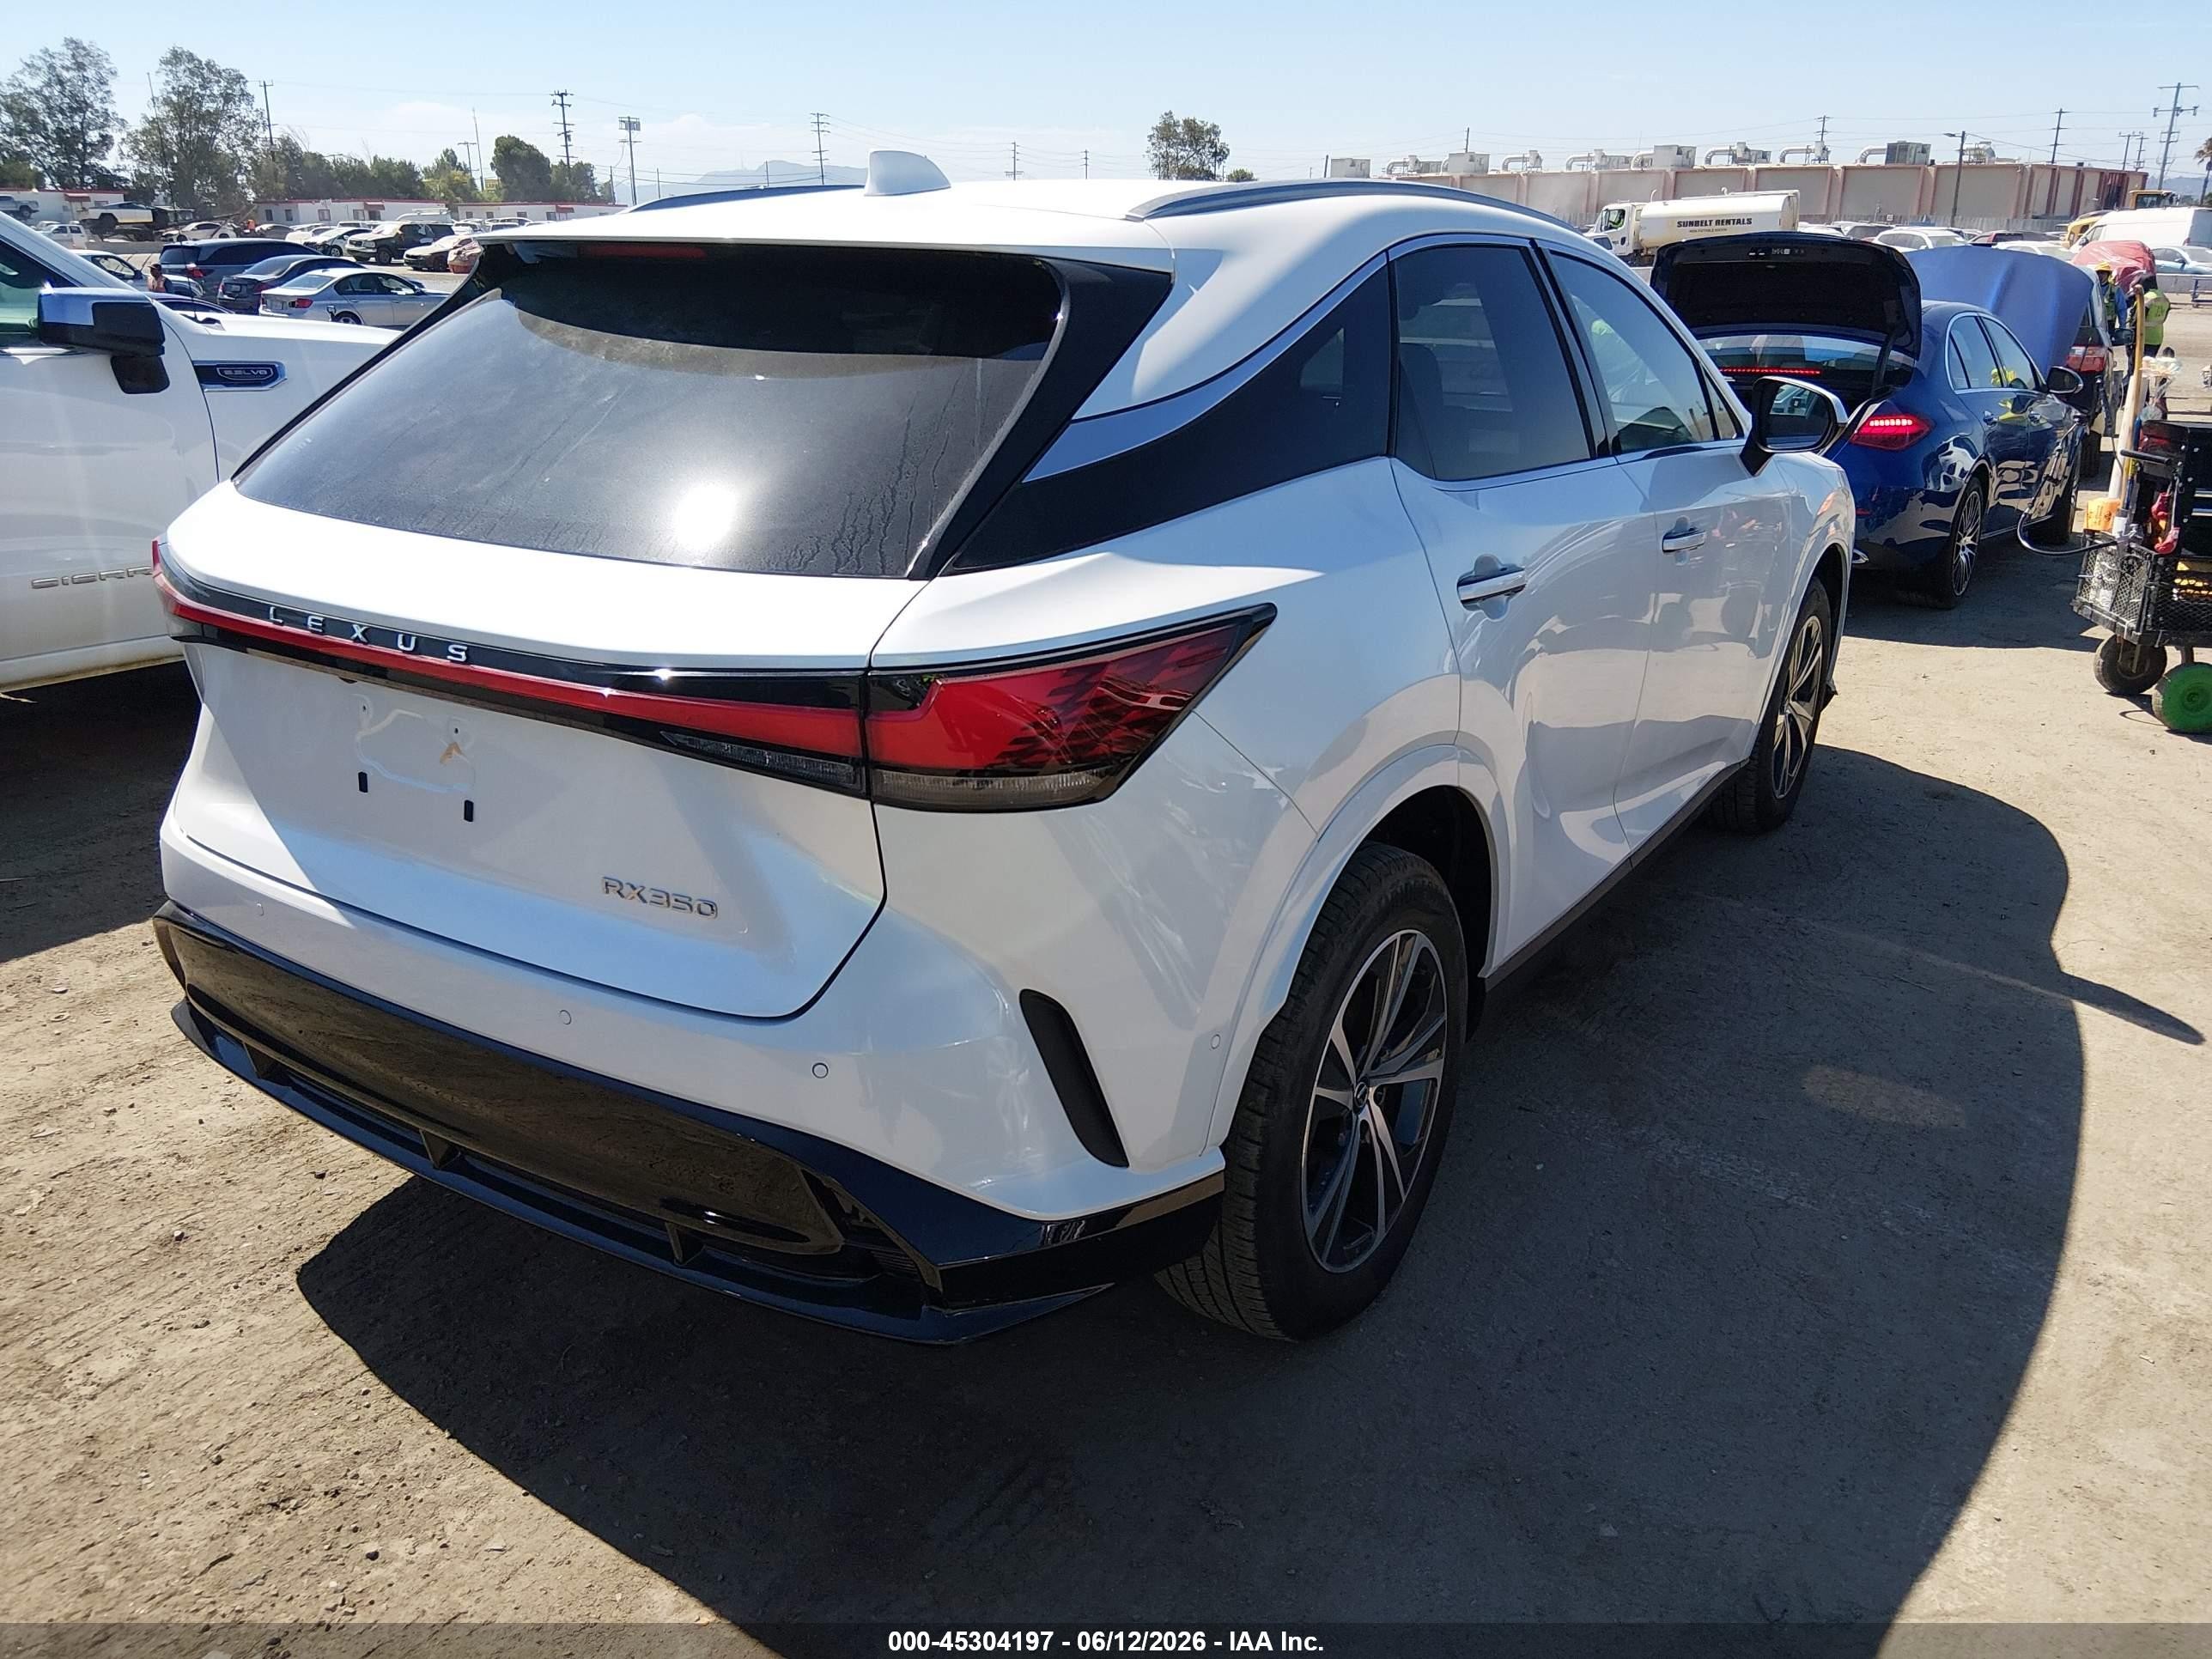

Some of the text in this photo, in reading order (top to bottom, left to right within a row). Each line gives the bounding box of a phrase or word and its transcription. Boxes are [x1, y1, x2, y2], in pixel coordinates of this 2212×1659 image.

[1676, 219, 1713, 228] SUNBELT
[31, 565, 153, 589] SIERR
[269, 606, 469, 662] LEXUS
[602, 876, 719, 920] RX350
